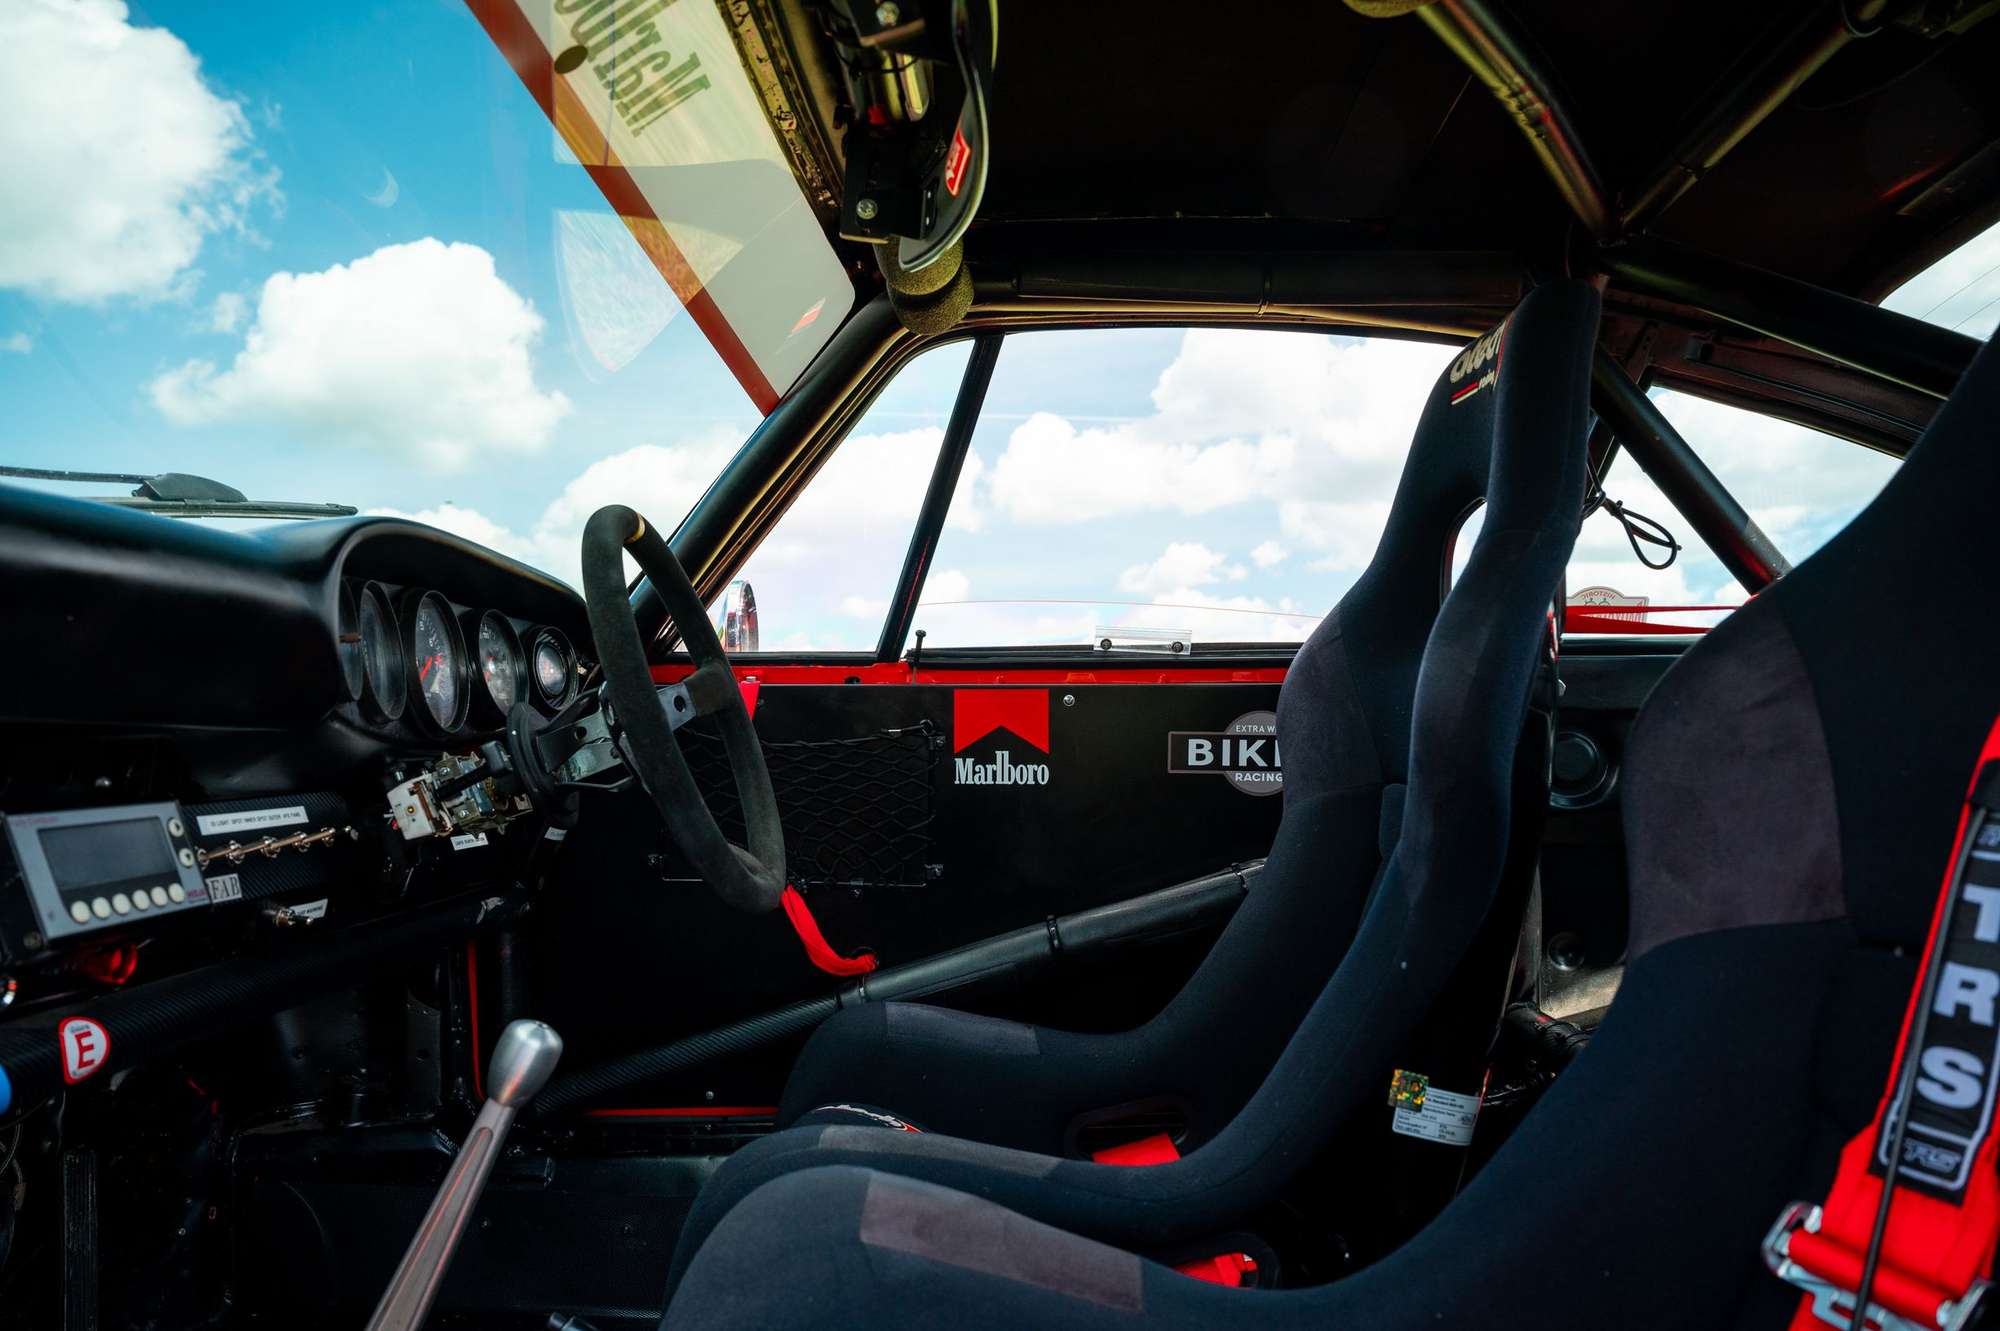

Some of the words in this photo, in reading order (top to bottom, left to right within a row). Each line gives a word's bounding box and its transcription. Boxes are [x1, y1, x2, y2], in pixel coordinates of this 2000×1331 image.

[1235, 725, 1264, 733] EXTRA
[954, 750, 1050, 785] Marlboro
[1235, 773, 1283, 782] RACING
[74, 1030, 95, 1069] E
